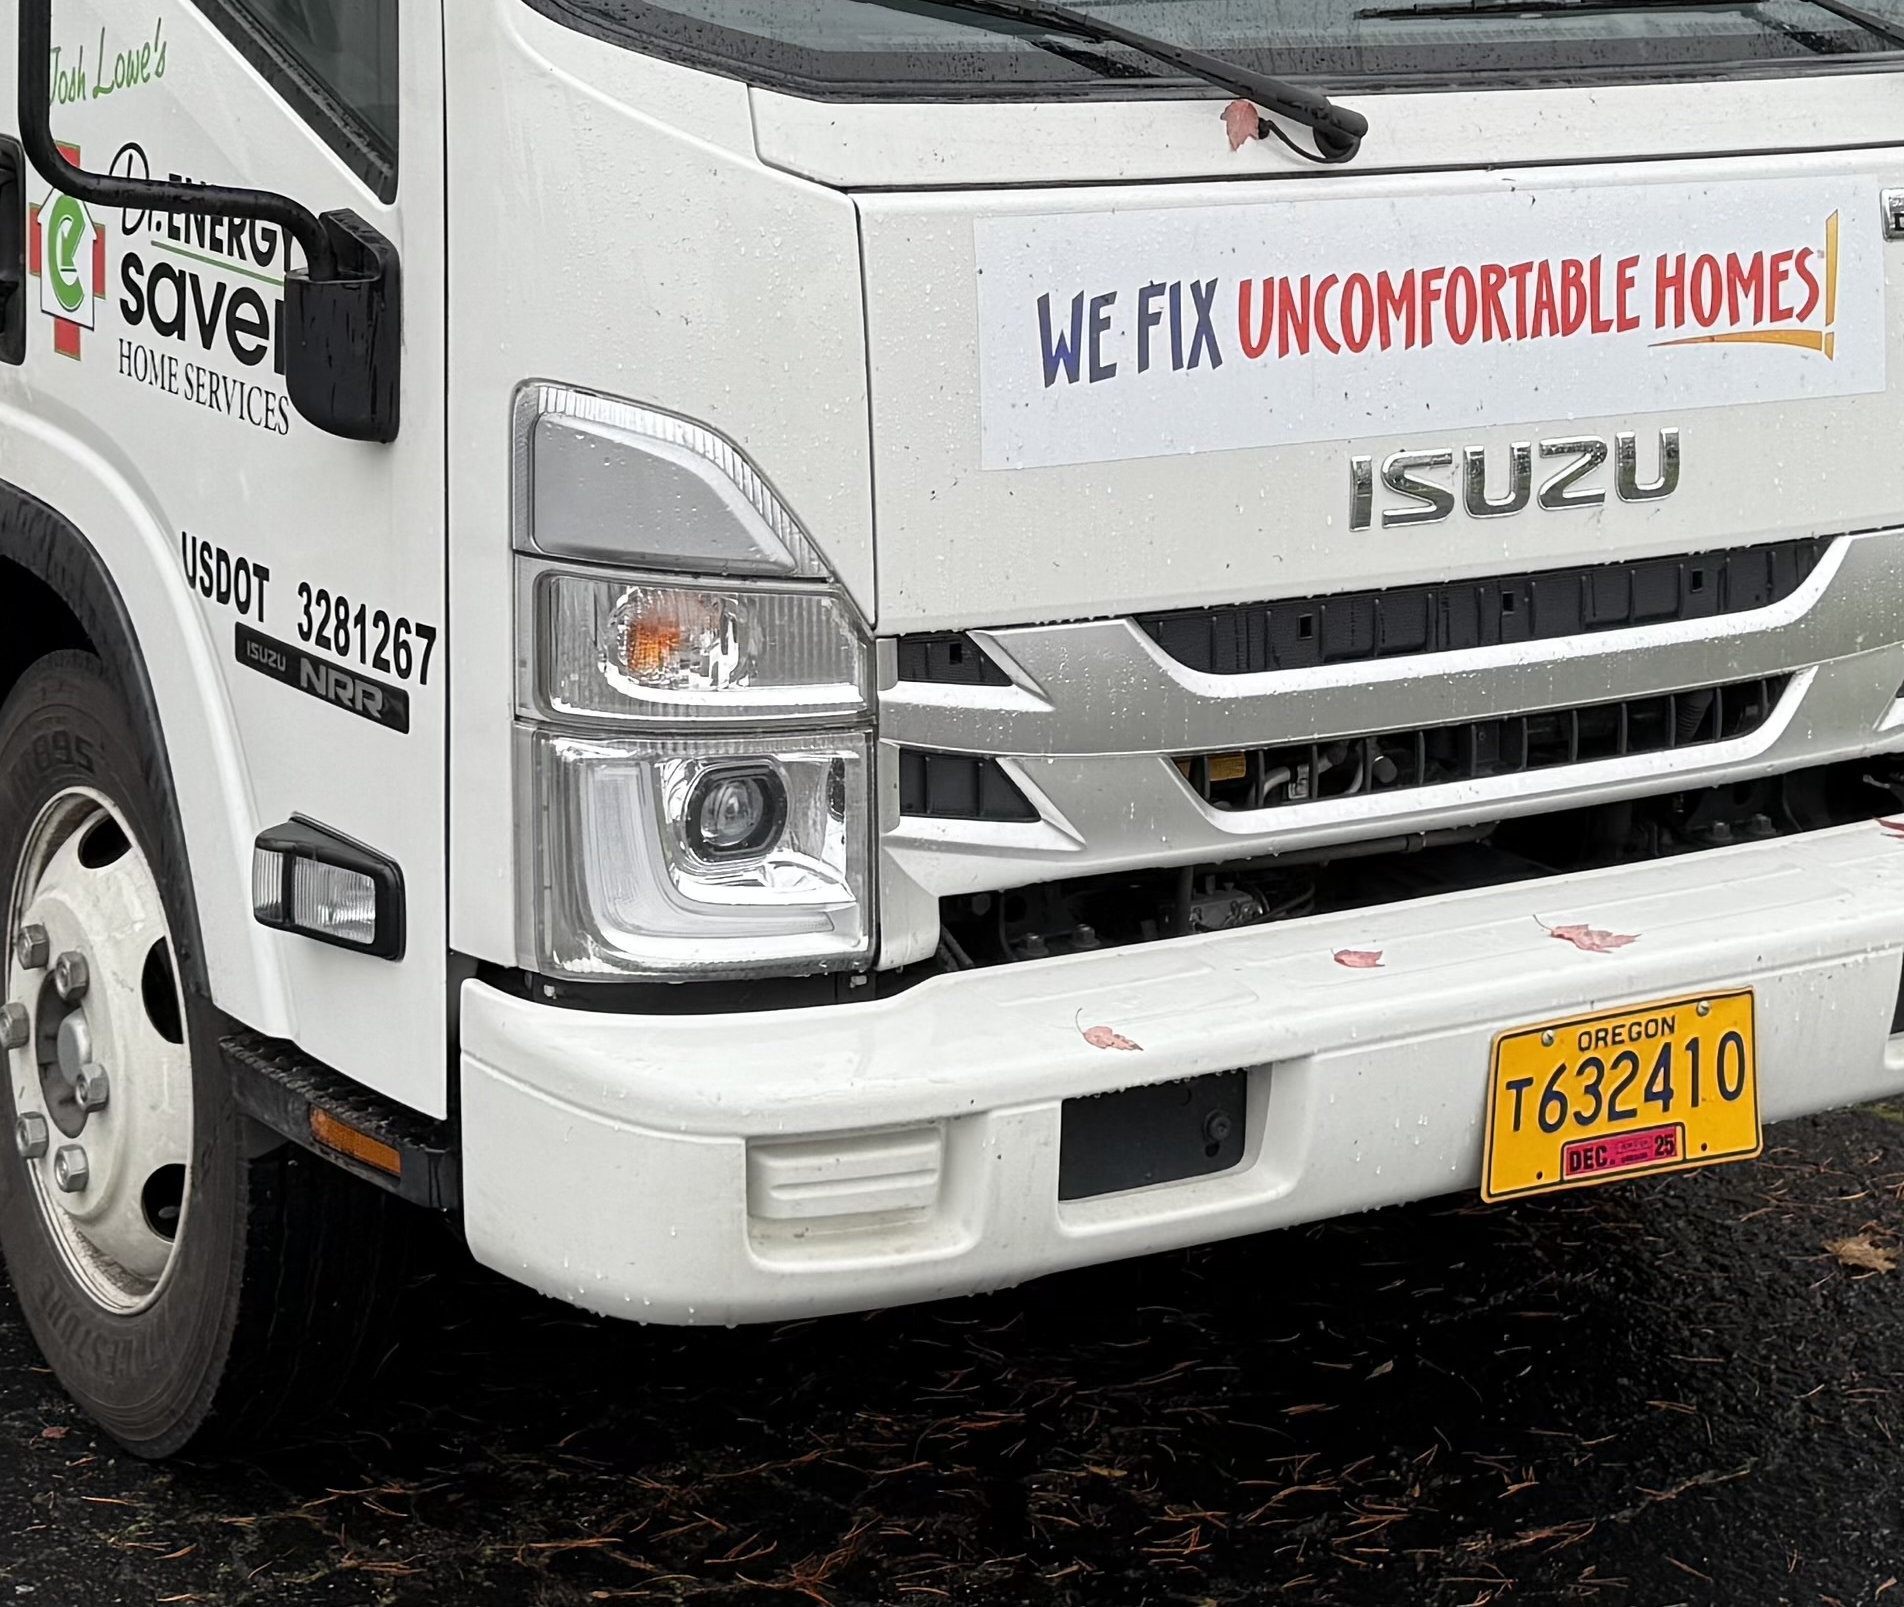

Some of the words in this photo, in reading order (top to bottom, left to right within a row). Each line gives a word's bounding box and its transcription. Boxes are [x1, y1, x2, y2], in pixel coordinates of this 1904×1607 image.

[49, 46, 86, 106] Josh
[92, 17, 168, 100] Lowe's
[1036, 290, 1118, 390] WE
[1136, 277, 1224, 374] FIX
[1236, 253, 1640, 360] UNCOMFORTABLE
[1655, 209, 1839, 361] HOMES!
[118, 339, 181, 397] HOME
[183, 367, 291, 436] SERVICES
[1348, 426, 1681, 533] ISUZU
[181, 531, 270, 623] USDOT
[297, 582, 437, 685] 3281267
[246, 640, 287, 672] ISUZU
[300, 657, 386, 719] NRR
[1577, 1014, 1677, 1052] OREGON
[1505, 1030, 1746, 1134] T632410
[1569, 1145, 1616, 1172] DEC.
[1654, 1134, 1675, 1156] 25
